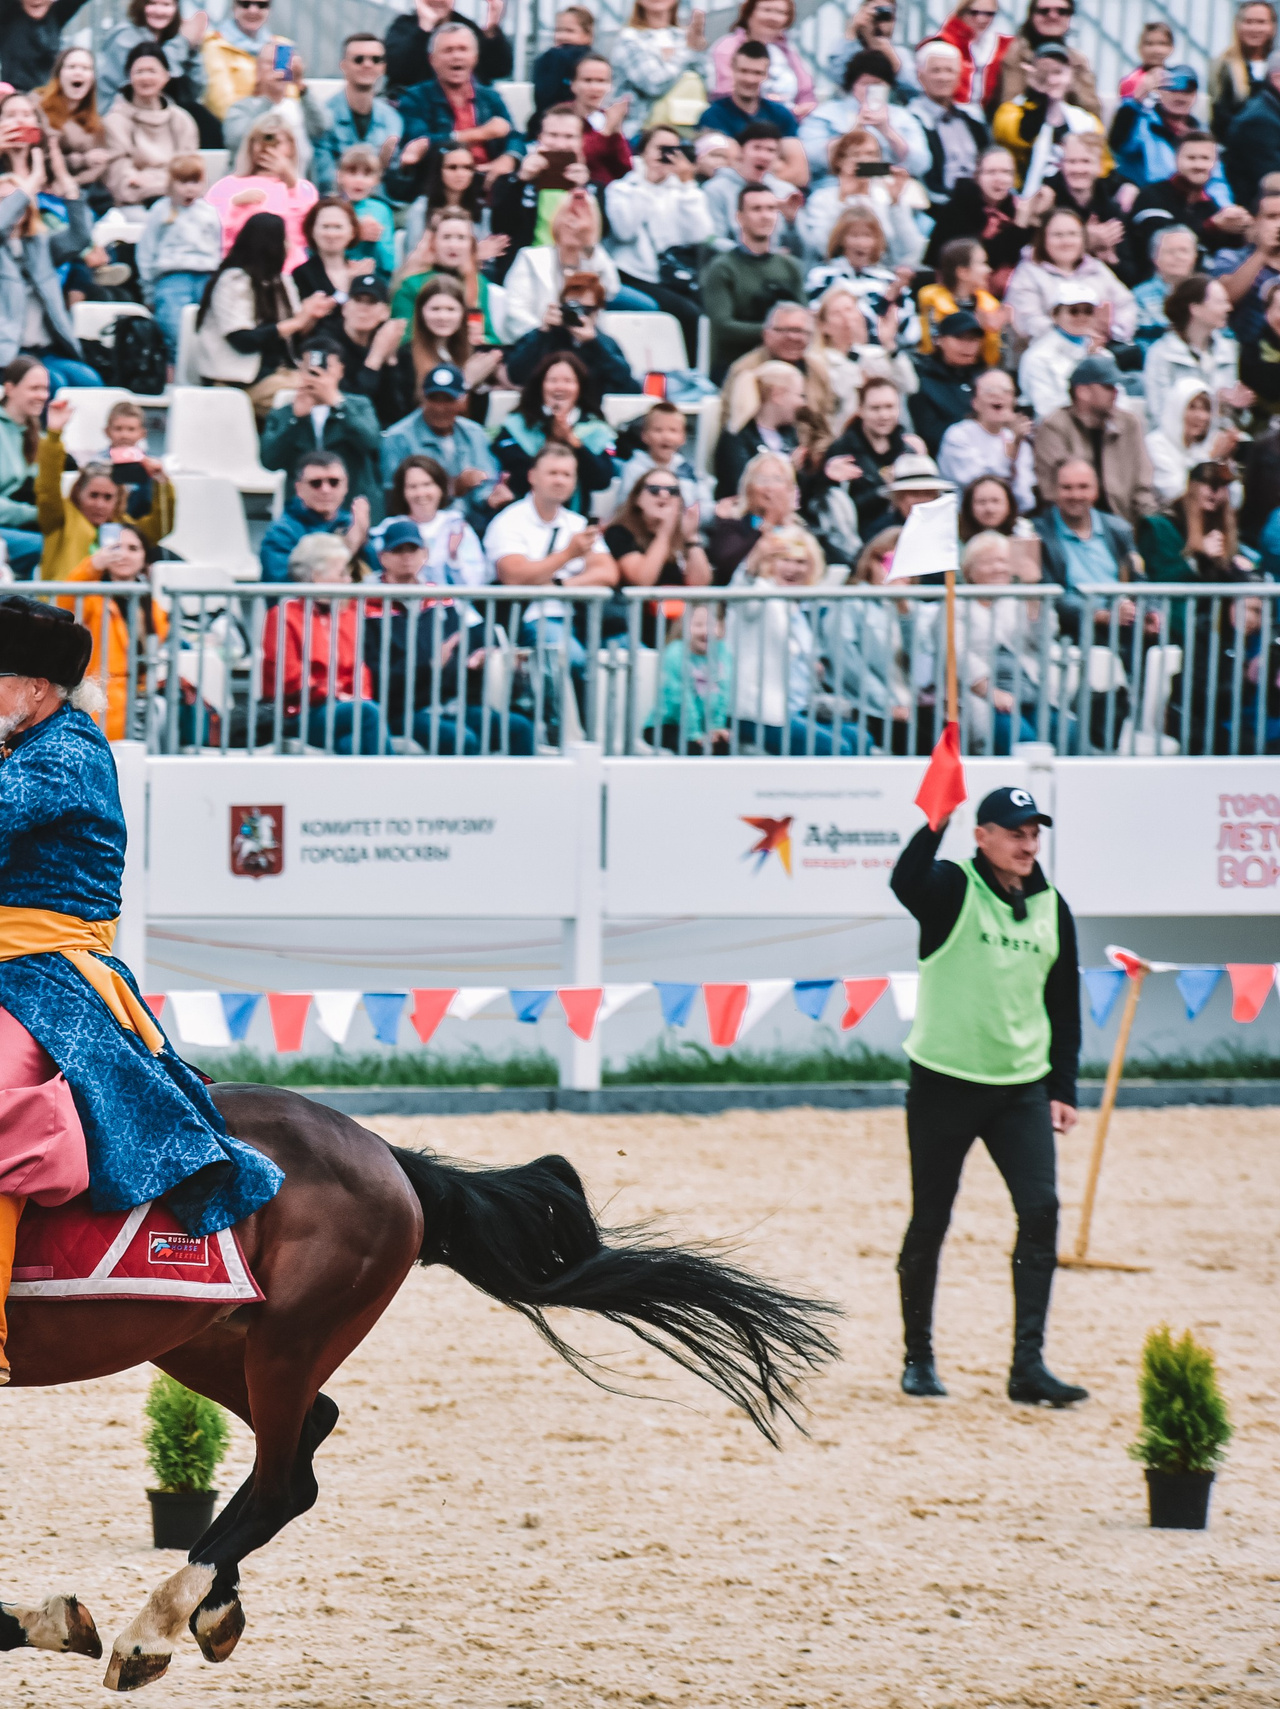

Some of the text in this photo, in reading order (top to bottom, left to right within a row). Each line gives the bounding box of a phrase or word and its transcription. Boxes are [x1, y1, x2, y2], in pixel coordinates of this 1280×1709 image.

[1218, 793, 1280, 817] ГОРО
[300, 817, 496, 836] КОМИТЕТ ПО ТУРИЗМУ
[1217, 822, 1280, 851] ЛЕТ
[300, 845, 451, 863] ГОРОДА МОСКВЫ
[167, 1236, 201, 1245] RUSSIAN
[171, 1244, 198, 1252] HORSE
[174, 1252, 205, 1261] TEXTILE
